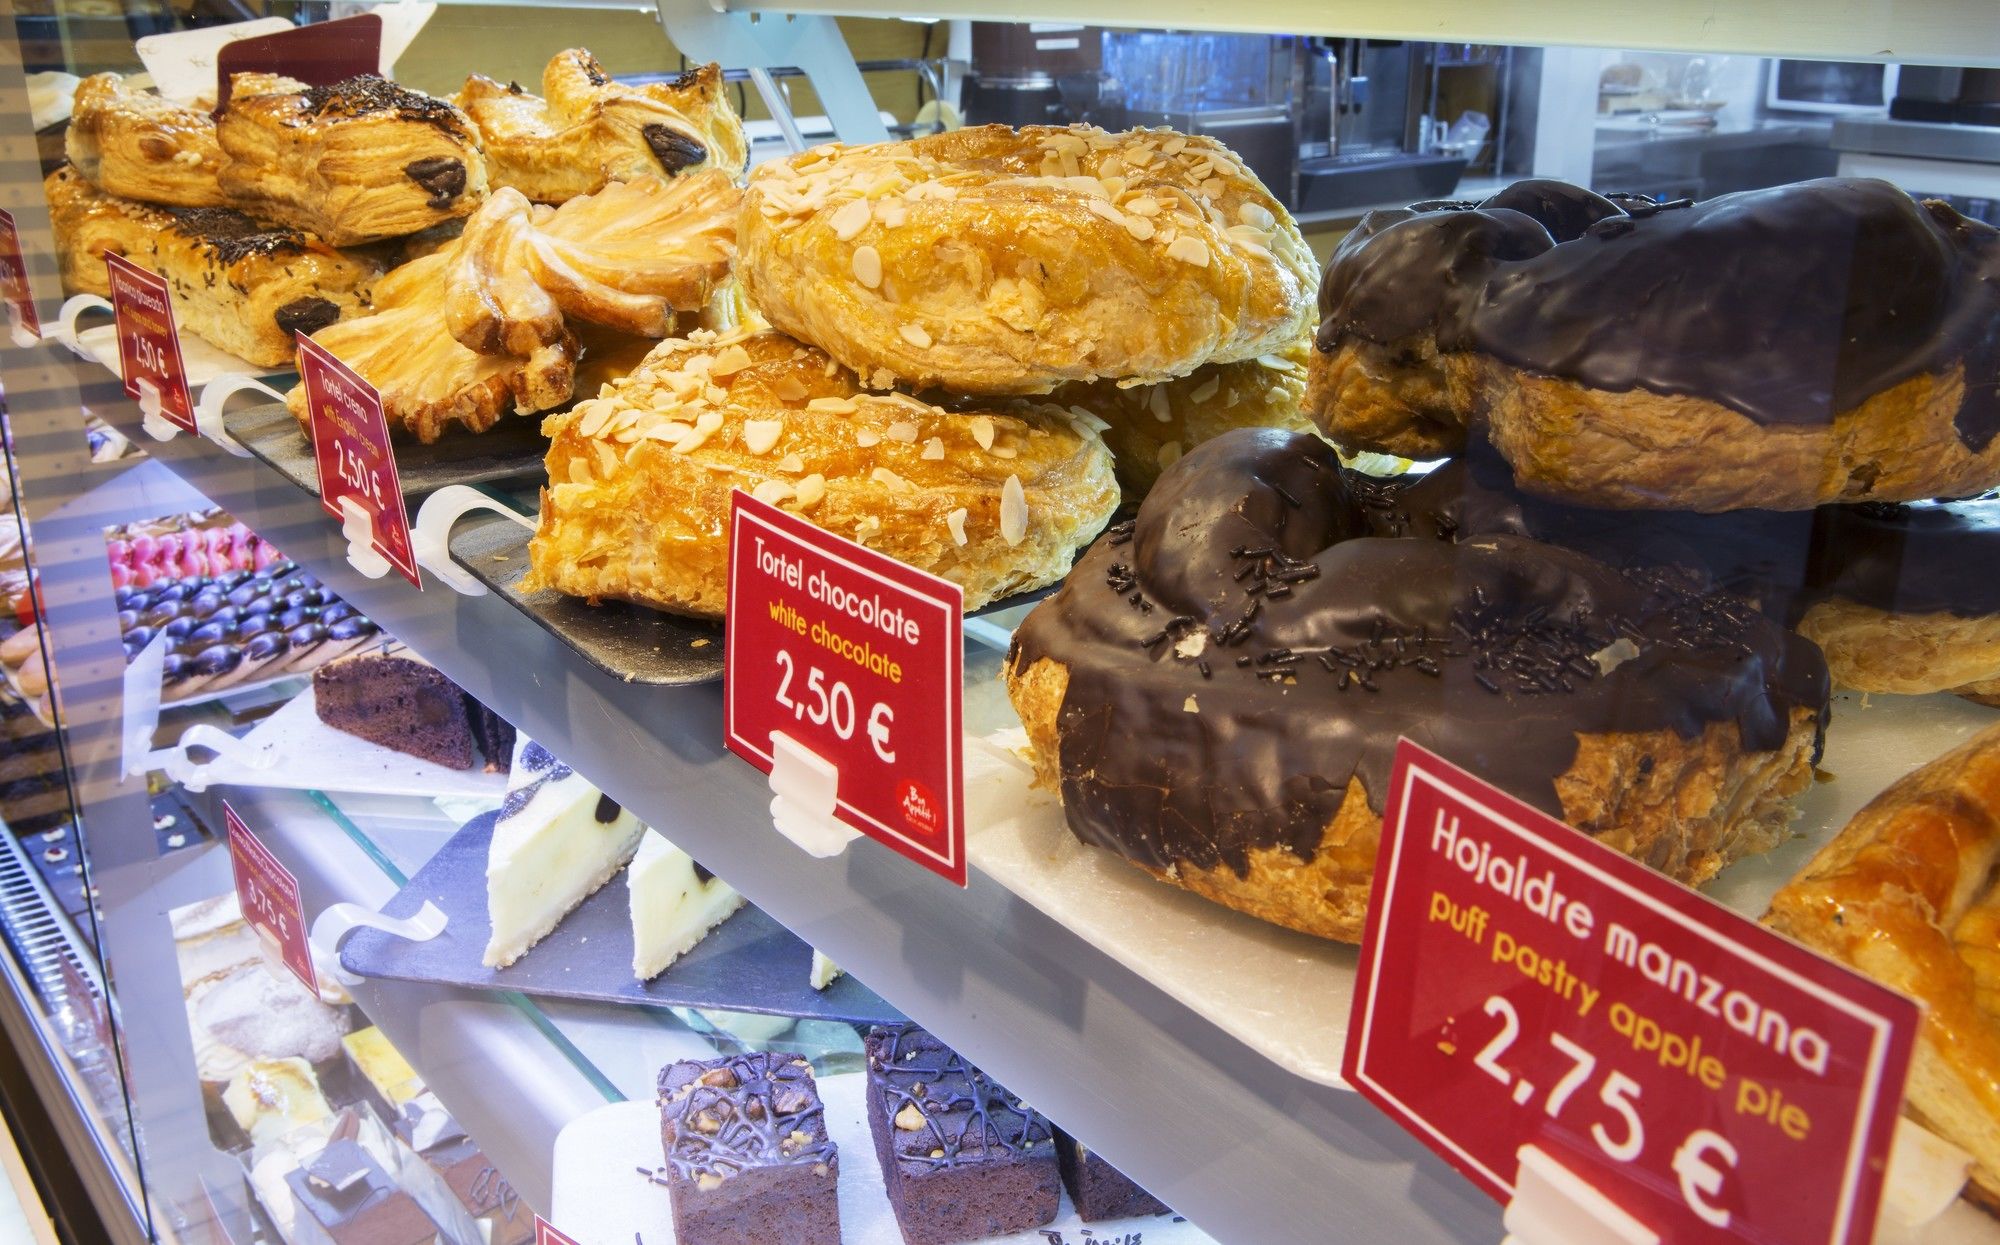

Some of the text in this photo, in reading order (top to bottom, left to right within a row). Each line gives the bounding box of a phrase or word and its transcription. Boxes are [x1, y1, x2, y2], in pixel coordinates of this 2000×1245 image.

[133, 332, 169, 379] 2,50 €
[319, 367, 369, 424] Tortel crema
[336, 408, 359, 442] English
[335, 439, 385, 511] 2,50 €
[755, 536, 920, 646] Tortel chocolate
[769, 600, 902, 684] white chocolate
[775, 650, 896, 764] 2,50 €
[910, 785, 926, 806] Bon
[248, 876, 290, 940] 3,75 €
[1431, 807, 1831, 1076] Hojaldre manzana
[1429, 890, 1811, 1141] puff pastry apple pie
[1473, 996, 1738, 1228] 2,75 €
